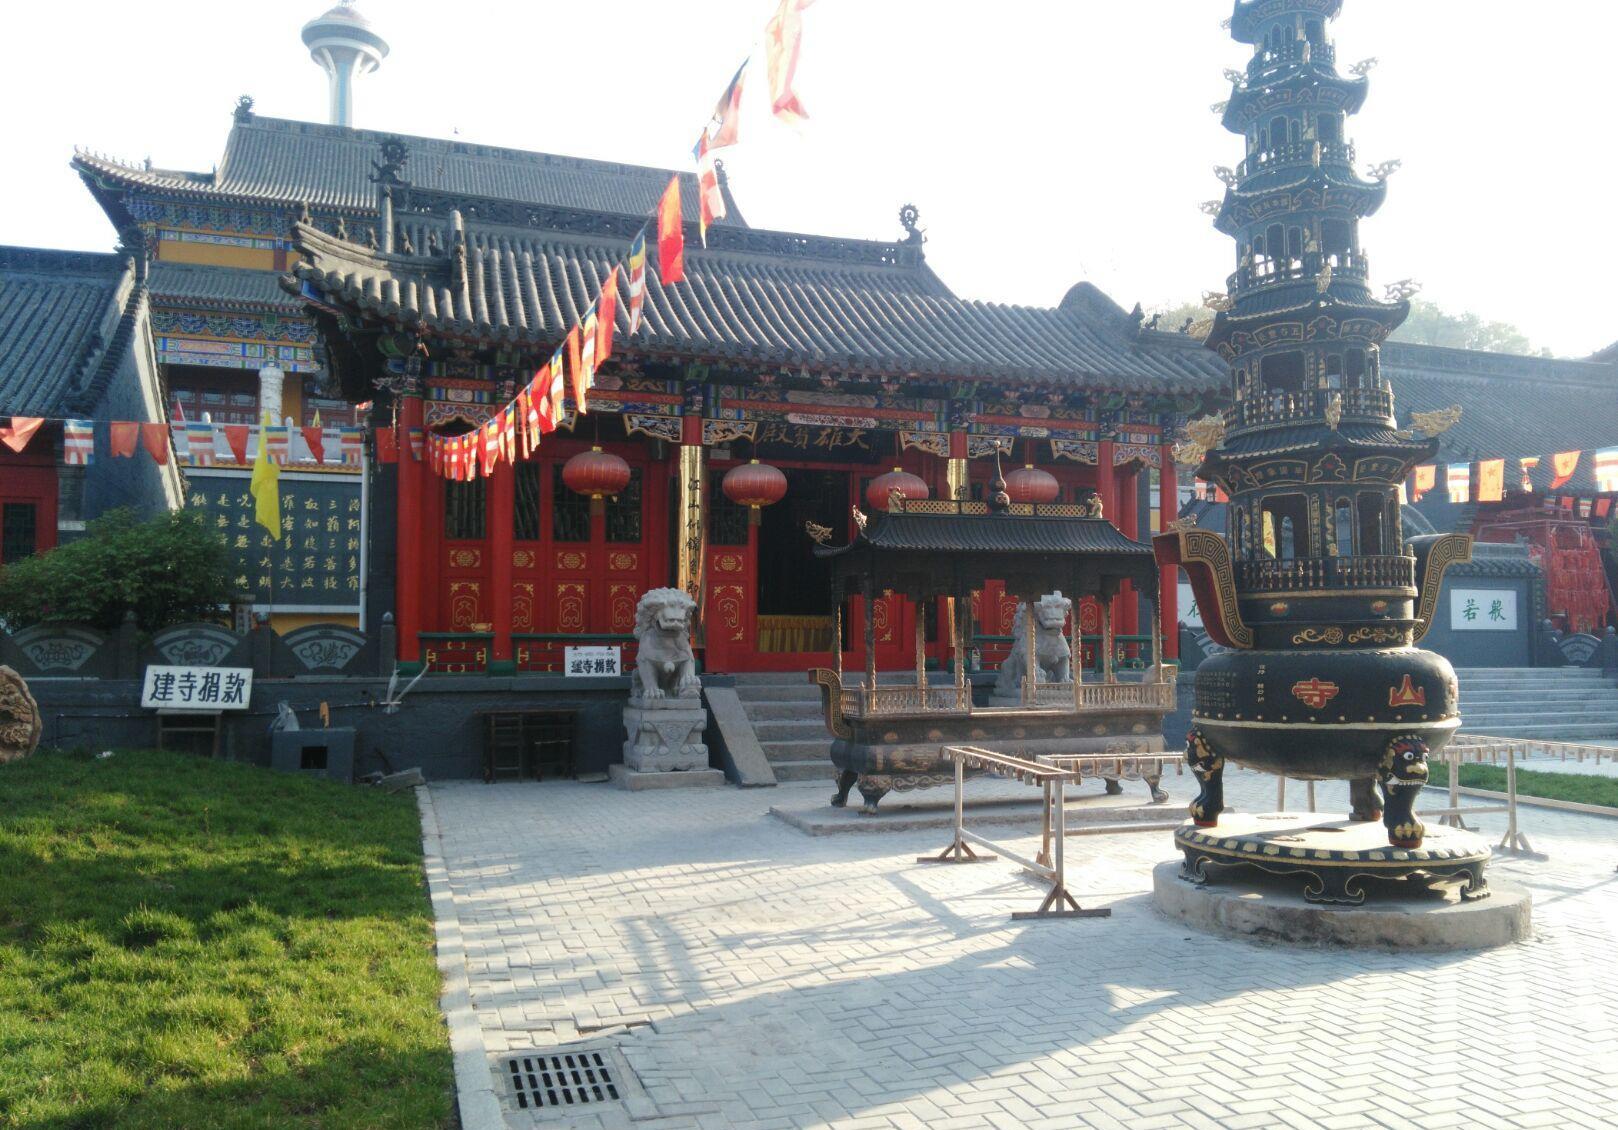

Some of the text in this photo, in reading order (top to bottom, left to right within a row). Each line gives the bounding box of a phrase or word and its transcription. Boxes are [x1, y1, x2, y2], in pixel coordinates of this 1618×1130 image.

[149, 671, 246, 704] 建寺捐款
[1291, 677, 1340, 709] 寺
[1388, 673, 1425, 707] 山
